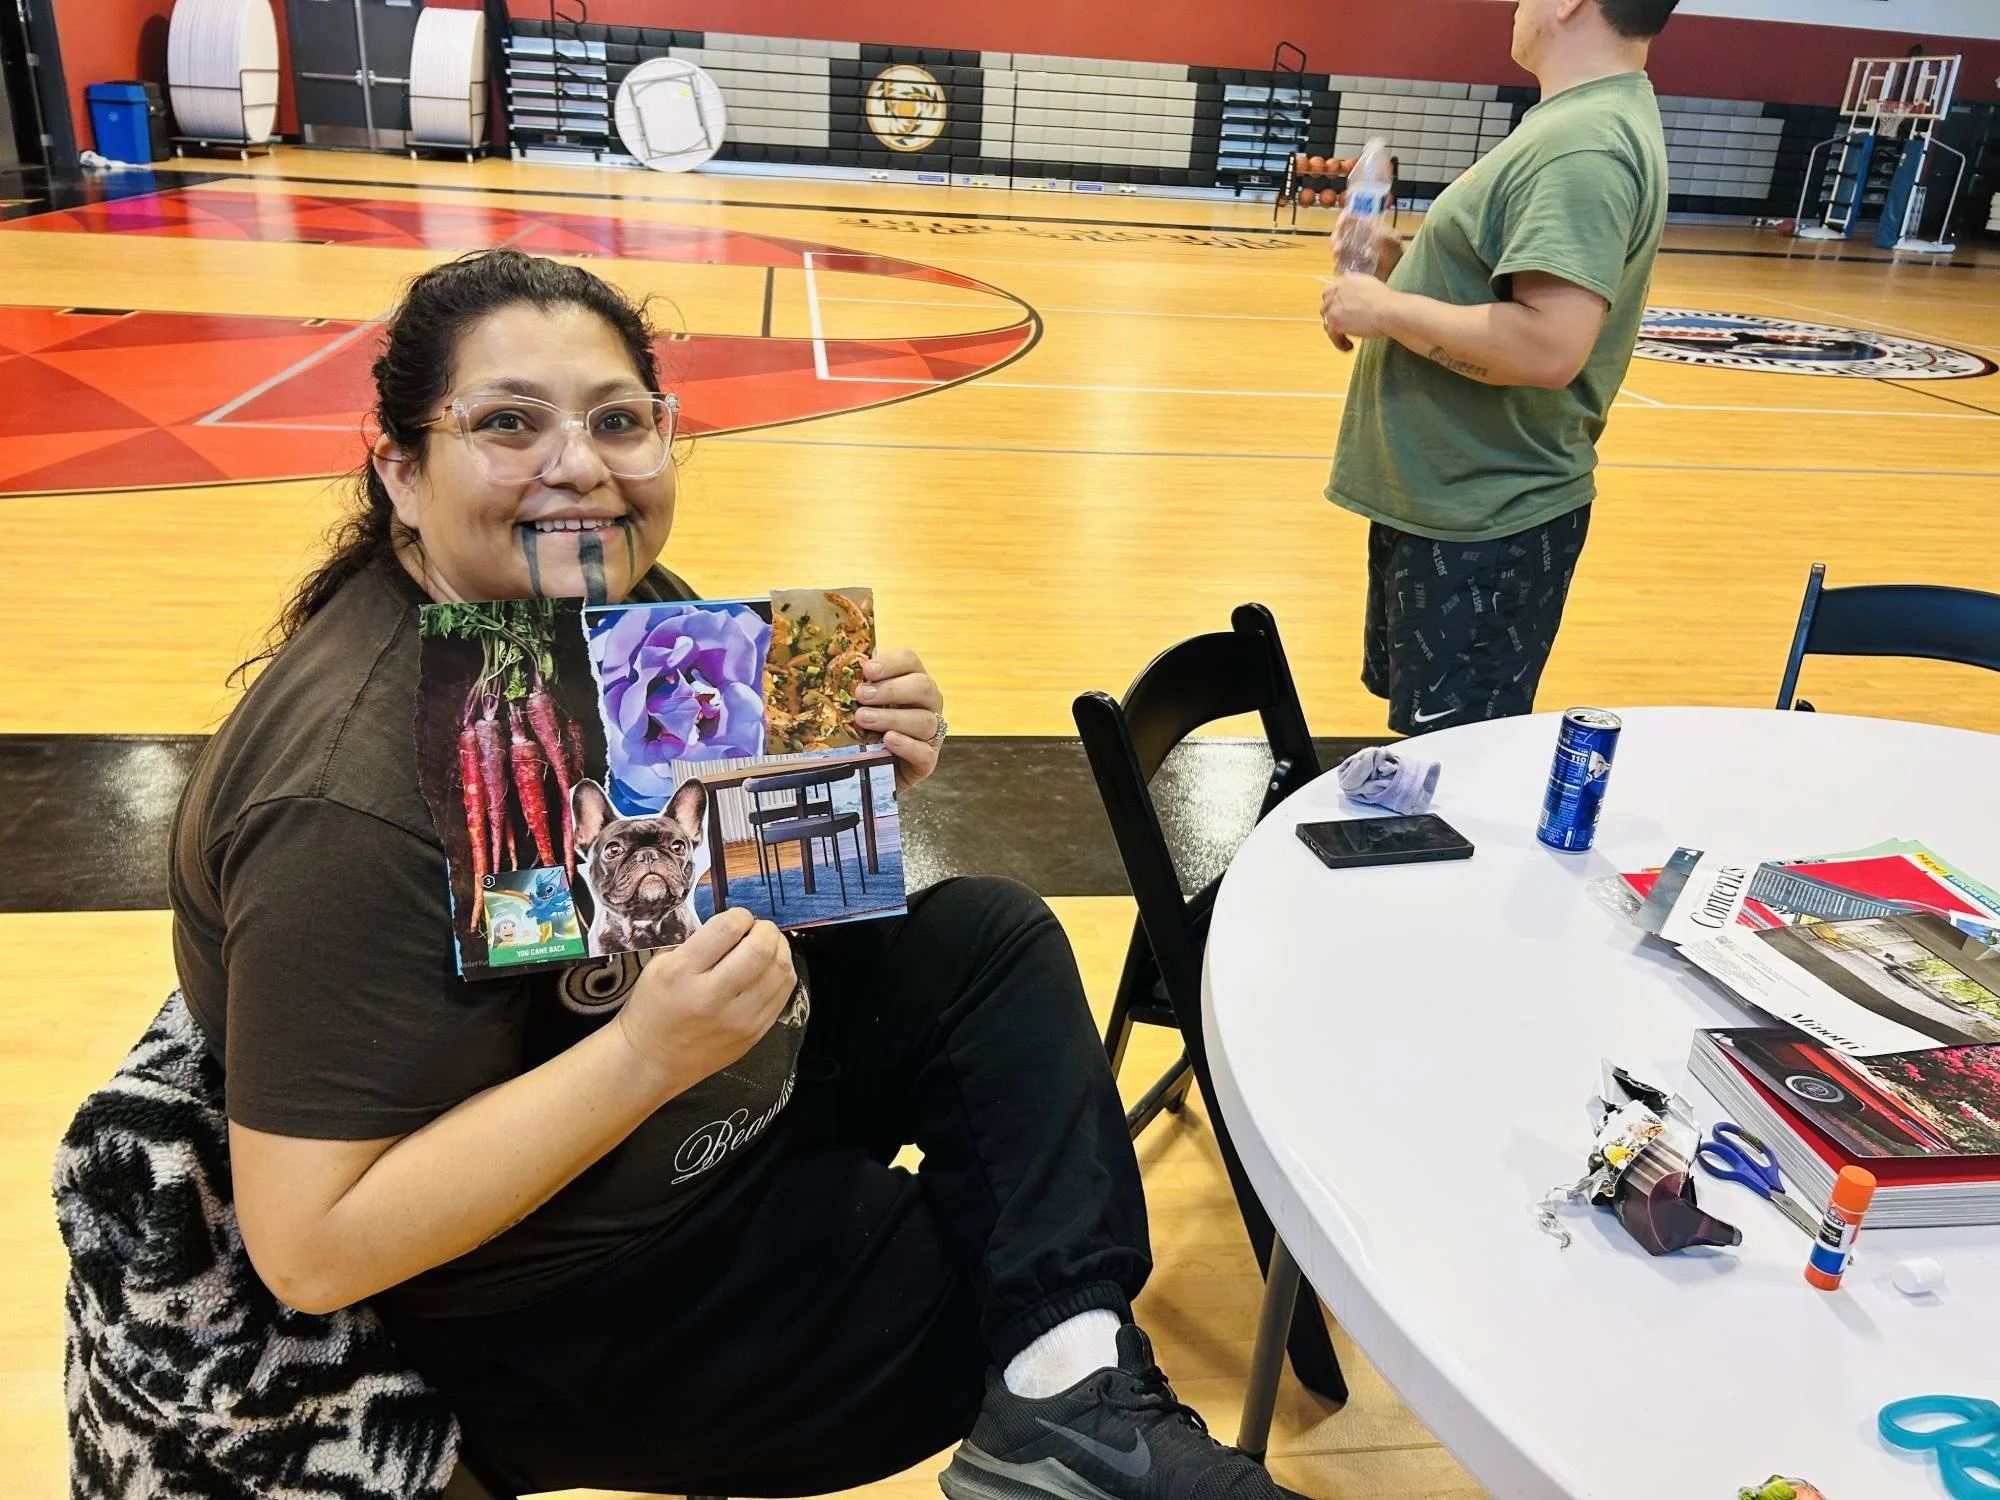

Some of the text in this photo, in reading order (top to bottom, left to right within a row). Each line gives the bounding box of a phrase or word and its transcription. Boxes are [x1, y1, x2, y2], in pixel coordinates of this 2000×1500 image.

[1429, 346, 1489, 378] Queen
[1435, 557, 1448, 576] JUST
[1414, 582, 1426, 608] NIKE
[1472, 594, 1484, 613] JUST
[1571, 754, 1587, 763] 110
[1916, 853, 1948, 876] NEW!
[1690, 865, 1747, 929] Contents
[1980, 895, 1998, 909] OUR
[516, 944, 566, 958] YOU CAME BACK
[1785, 1012, 1866, 1050] Minotti
